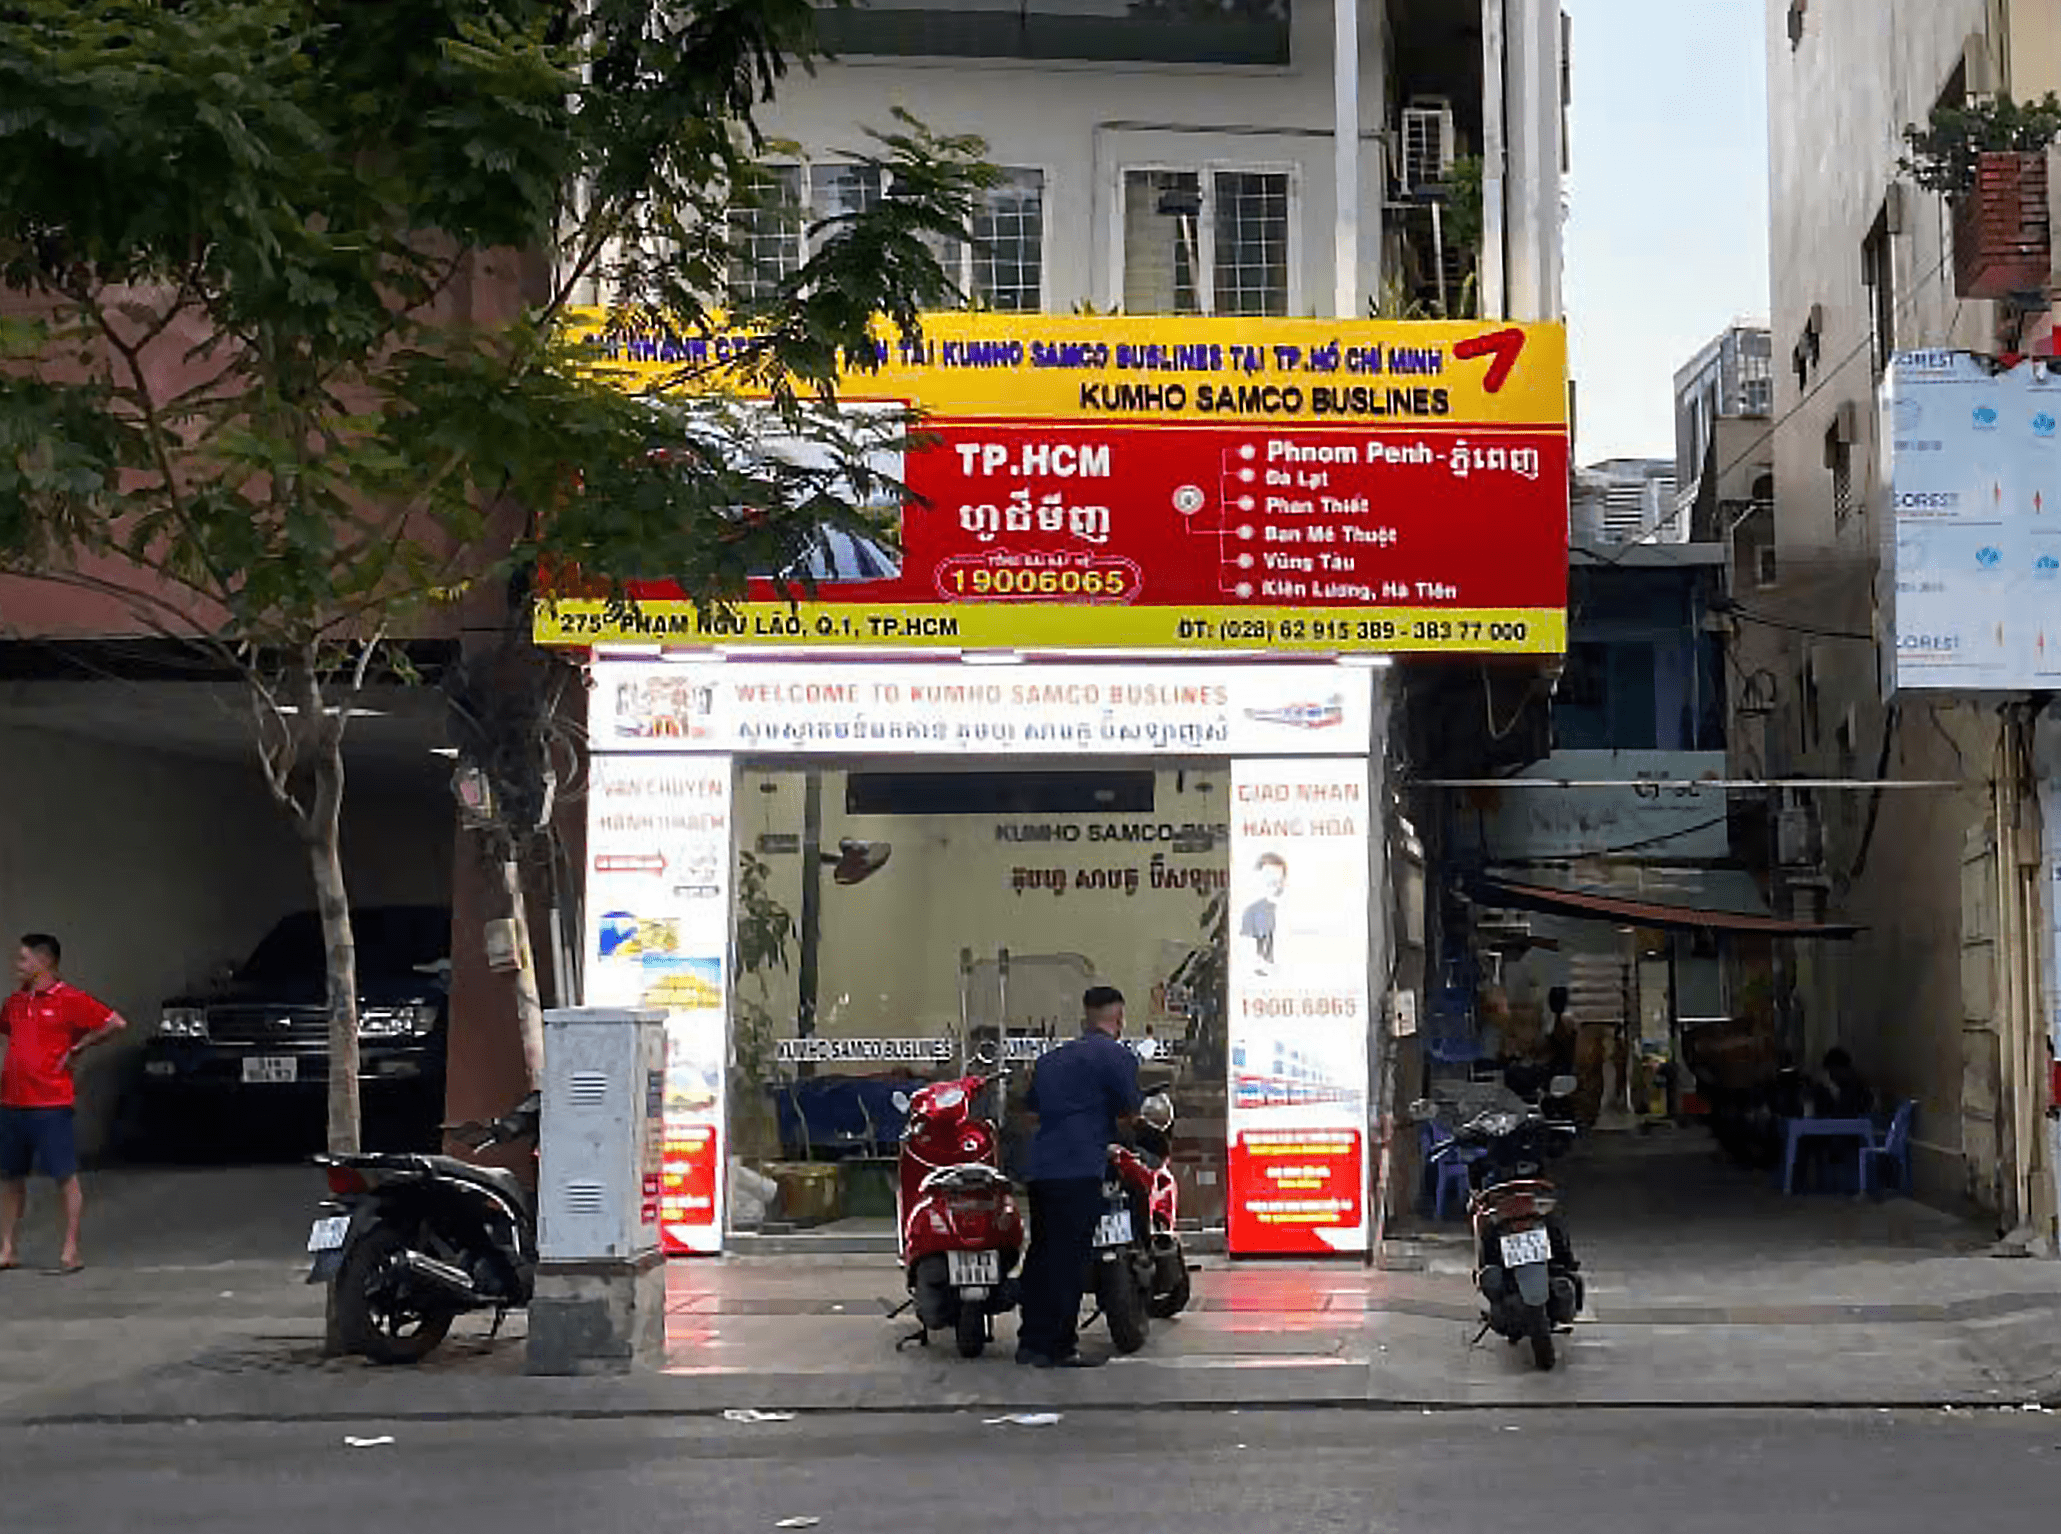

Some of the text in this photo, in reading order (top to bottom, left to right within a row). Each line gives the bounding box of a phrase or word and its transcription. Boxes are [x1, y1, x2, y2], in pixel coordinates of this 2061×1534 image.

[943, 341, 1024, 367] KUMHO
[1030, 341, 1107, 368] SAMCO
[1115, 344, 1221, 371] BUSLINES
[1389, 348, 1442, 375] MINH
[1079, 383, 1450, 416] KUMHO SAMCO BUSLINES
[955, 443, 1110, 477] TP.HCM
[1267, 440, 1357, 463] Phnom
[1265, 497, 1314, 514] Phan
[1263, 552, 1314, 572] Vũng
[950, 568, 1125, 594] 19006065
[620, 614, 689, 639] PHẠM
[869, 617, 958, 637] TP.HCM
[1220, 619, 1274, 641] (028)
[1280, 619, 1305, 639] 62
[1313, 620, 1349, 640] 915
[1356, 621, 1395, 640] 389
[1413, 621, 1451, 641] 383
[1458, 622, 1482, 641] 77
[1490, 622, 1526, 642] 000
[735, 683, 1228, 705] WELCOME TO KUMHO SAMCO BUSLINES
[996, 824, 1081, 842] KUMHO
[1086, 824, 1173, 842] SAMCO
